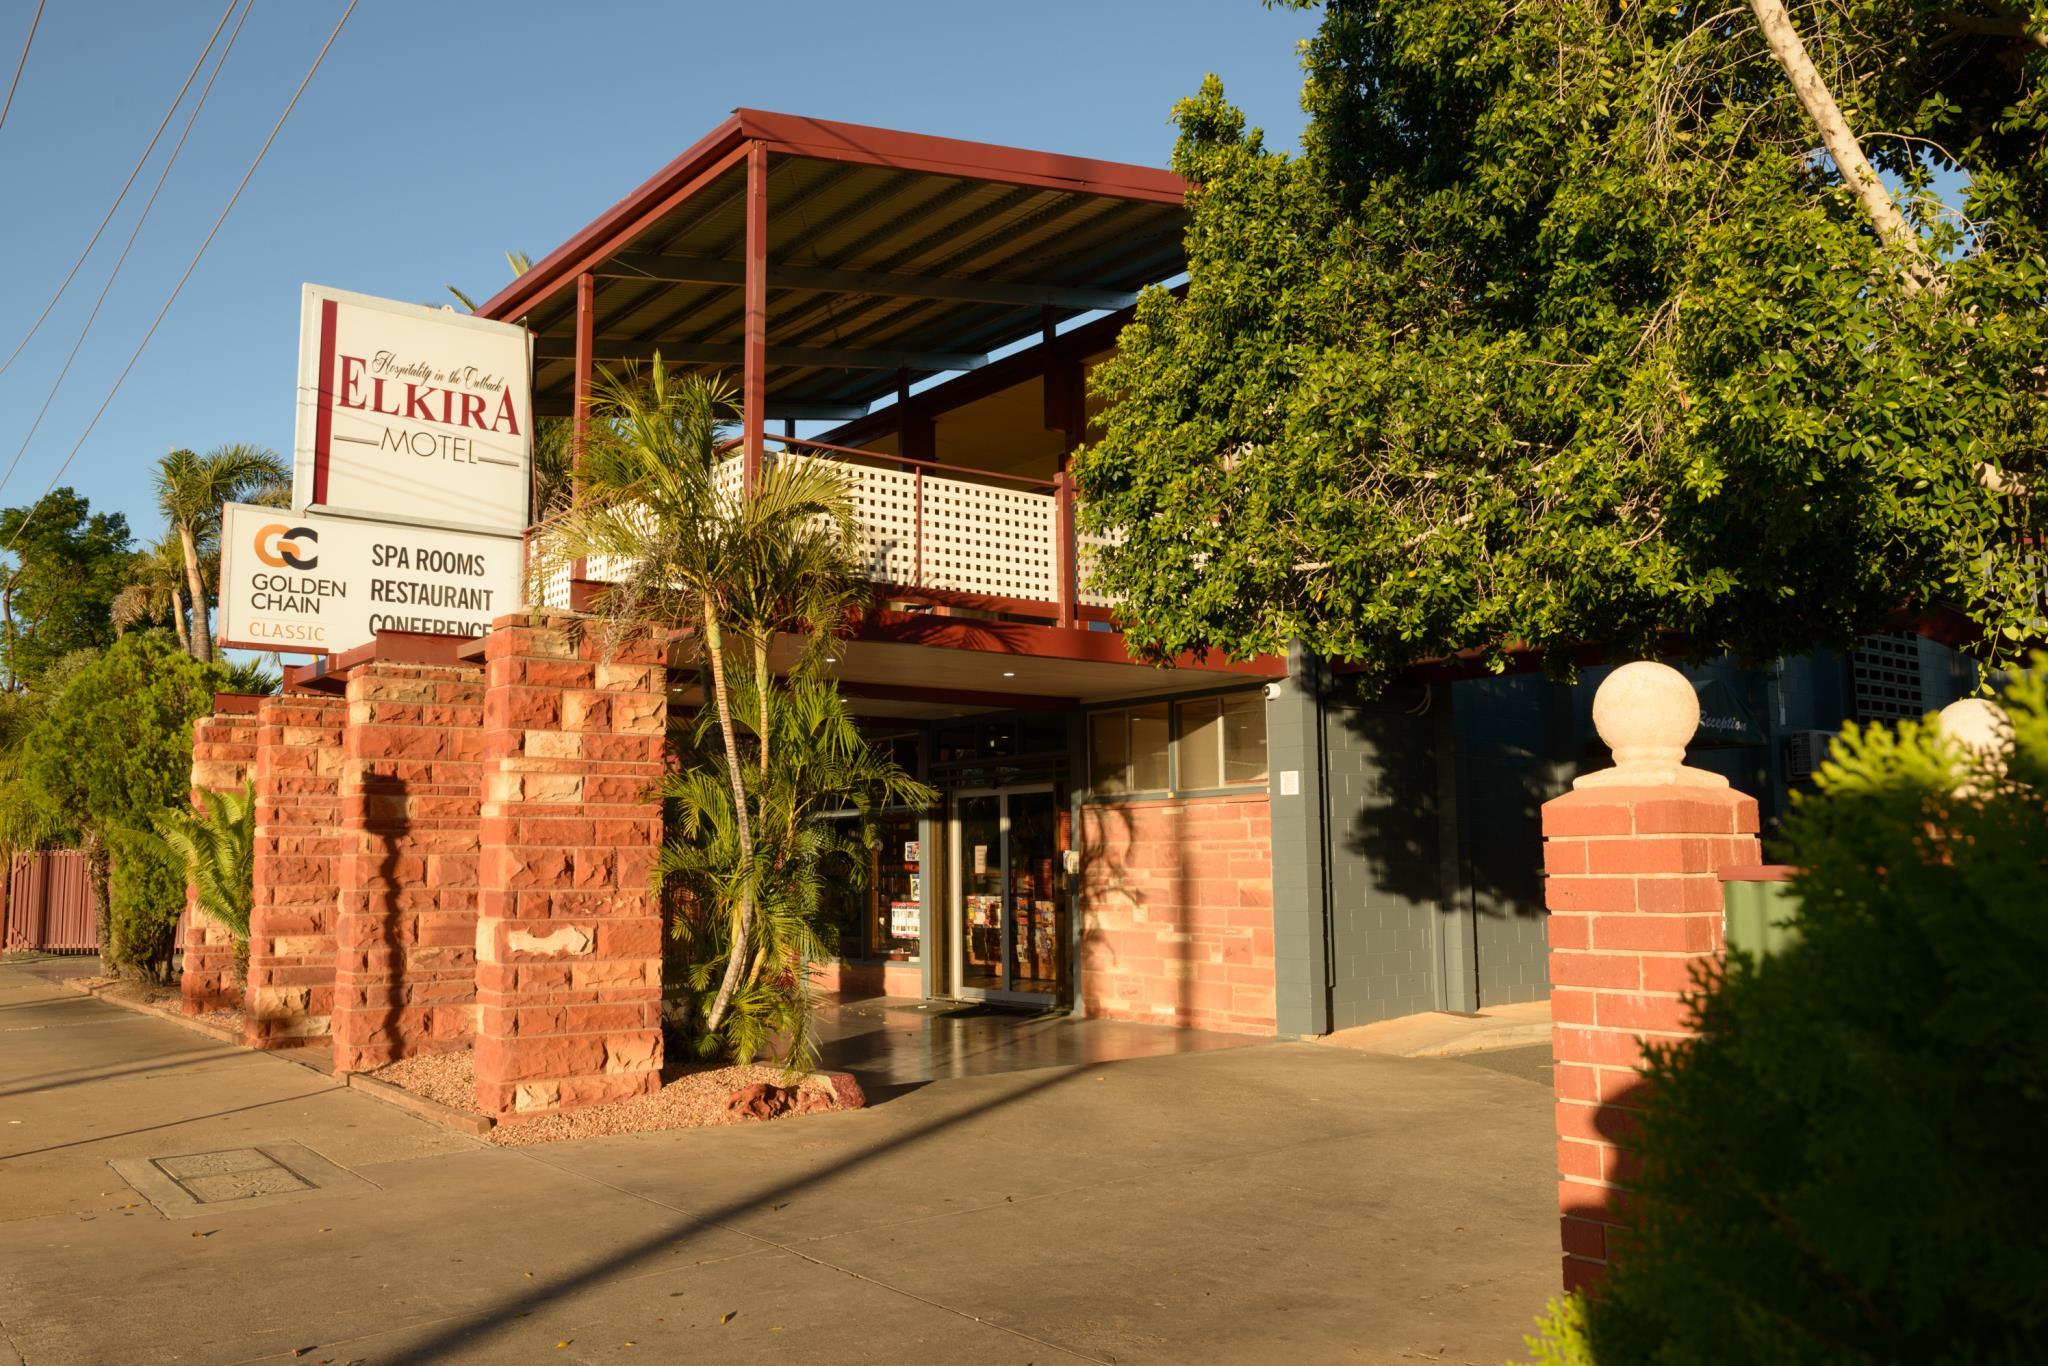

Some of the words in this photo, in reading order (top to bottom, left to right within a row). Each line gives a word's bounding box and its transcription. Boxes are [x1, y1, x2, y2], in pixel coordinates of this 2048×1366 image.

[372, 350, 432, 386] Hospitality
[434, 369, 443, 381] in
[448, 368, 461, 385] the
[464, 366, 504, 392] Outback
[336, 354, 521, 436] ELKIRA
[380, 427, 477, 465] MOTEL
[372, 543, 409, 569] SPA
[416, 548, 485, 577] ROOMS
[251, 573, 347, 598] GOLDEN
[370, 578, 494, 612] RESTAURANT
[251, 592, 320, 615] CHAIN
[249, 621, 325, 641] CLASSIC
